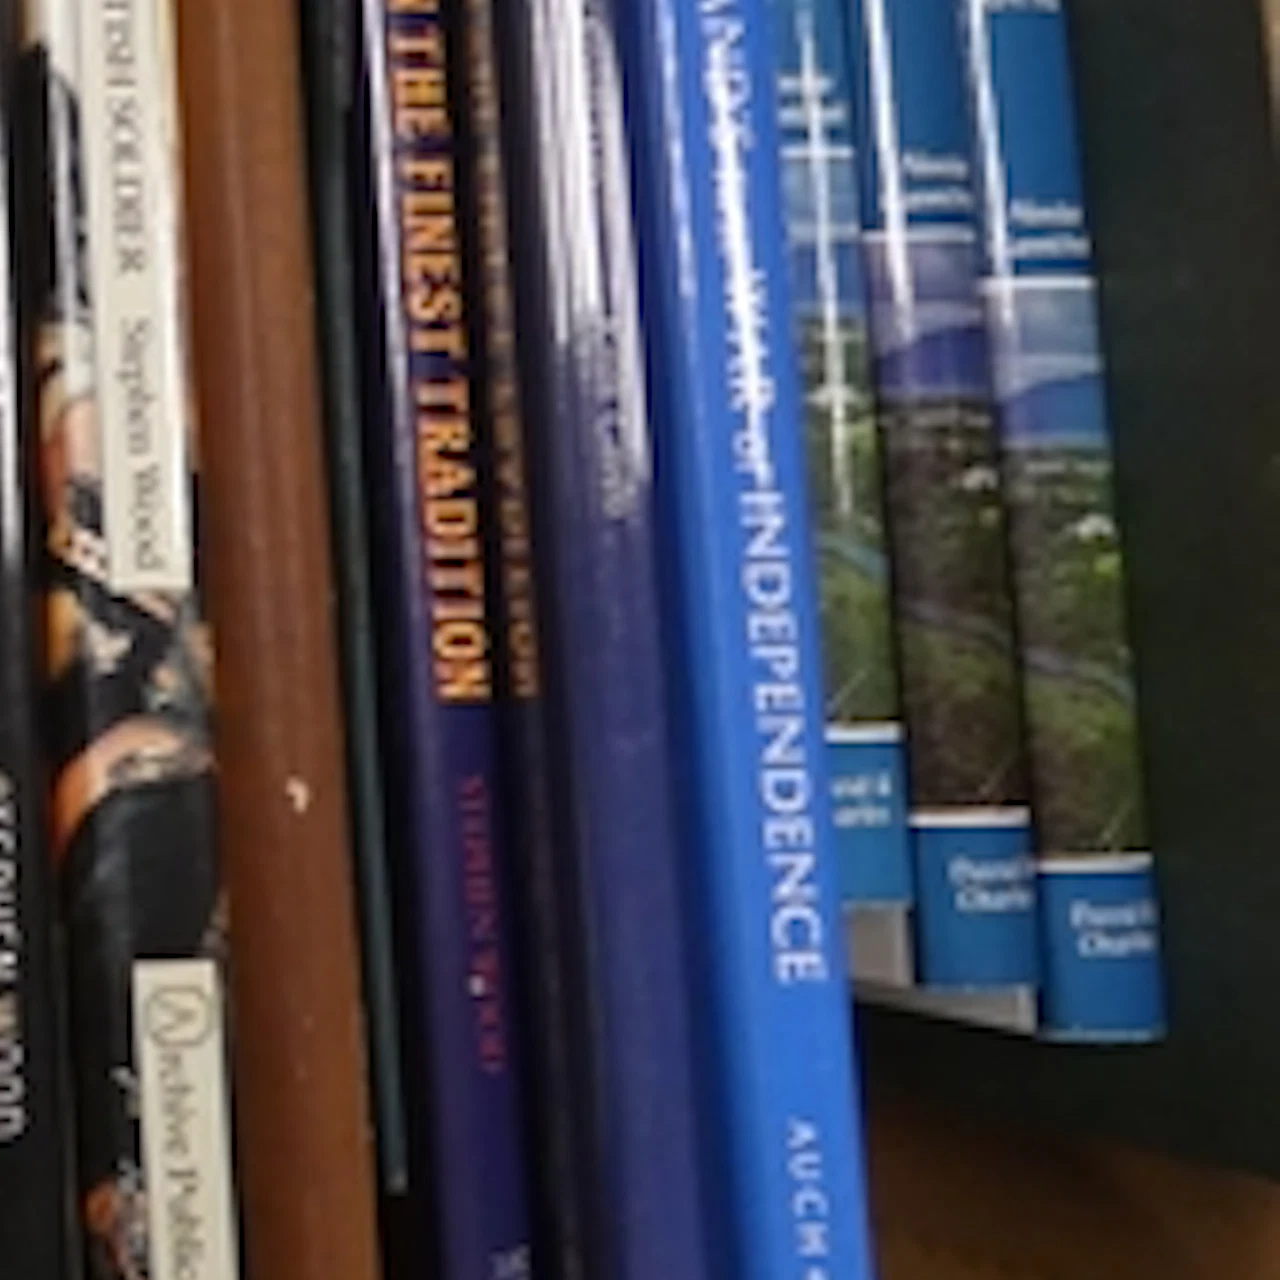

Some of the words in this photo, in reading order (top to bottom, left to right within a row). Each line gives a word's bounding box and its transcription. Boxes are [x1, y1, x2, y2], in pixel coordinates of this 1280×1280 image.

[392, 25, 449, 140] THE
[108, 98, 146, 274] SOLDIER
[400, 160, 466, 358] FINEST
[113, 315, 152, 456] Stephen
[128, 464, 163, 569] Wood
[417, 378, 491, 703] TRADITION
[739, 490, 825, 984] INDEPENDENCE
